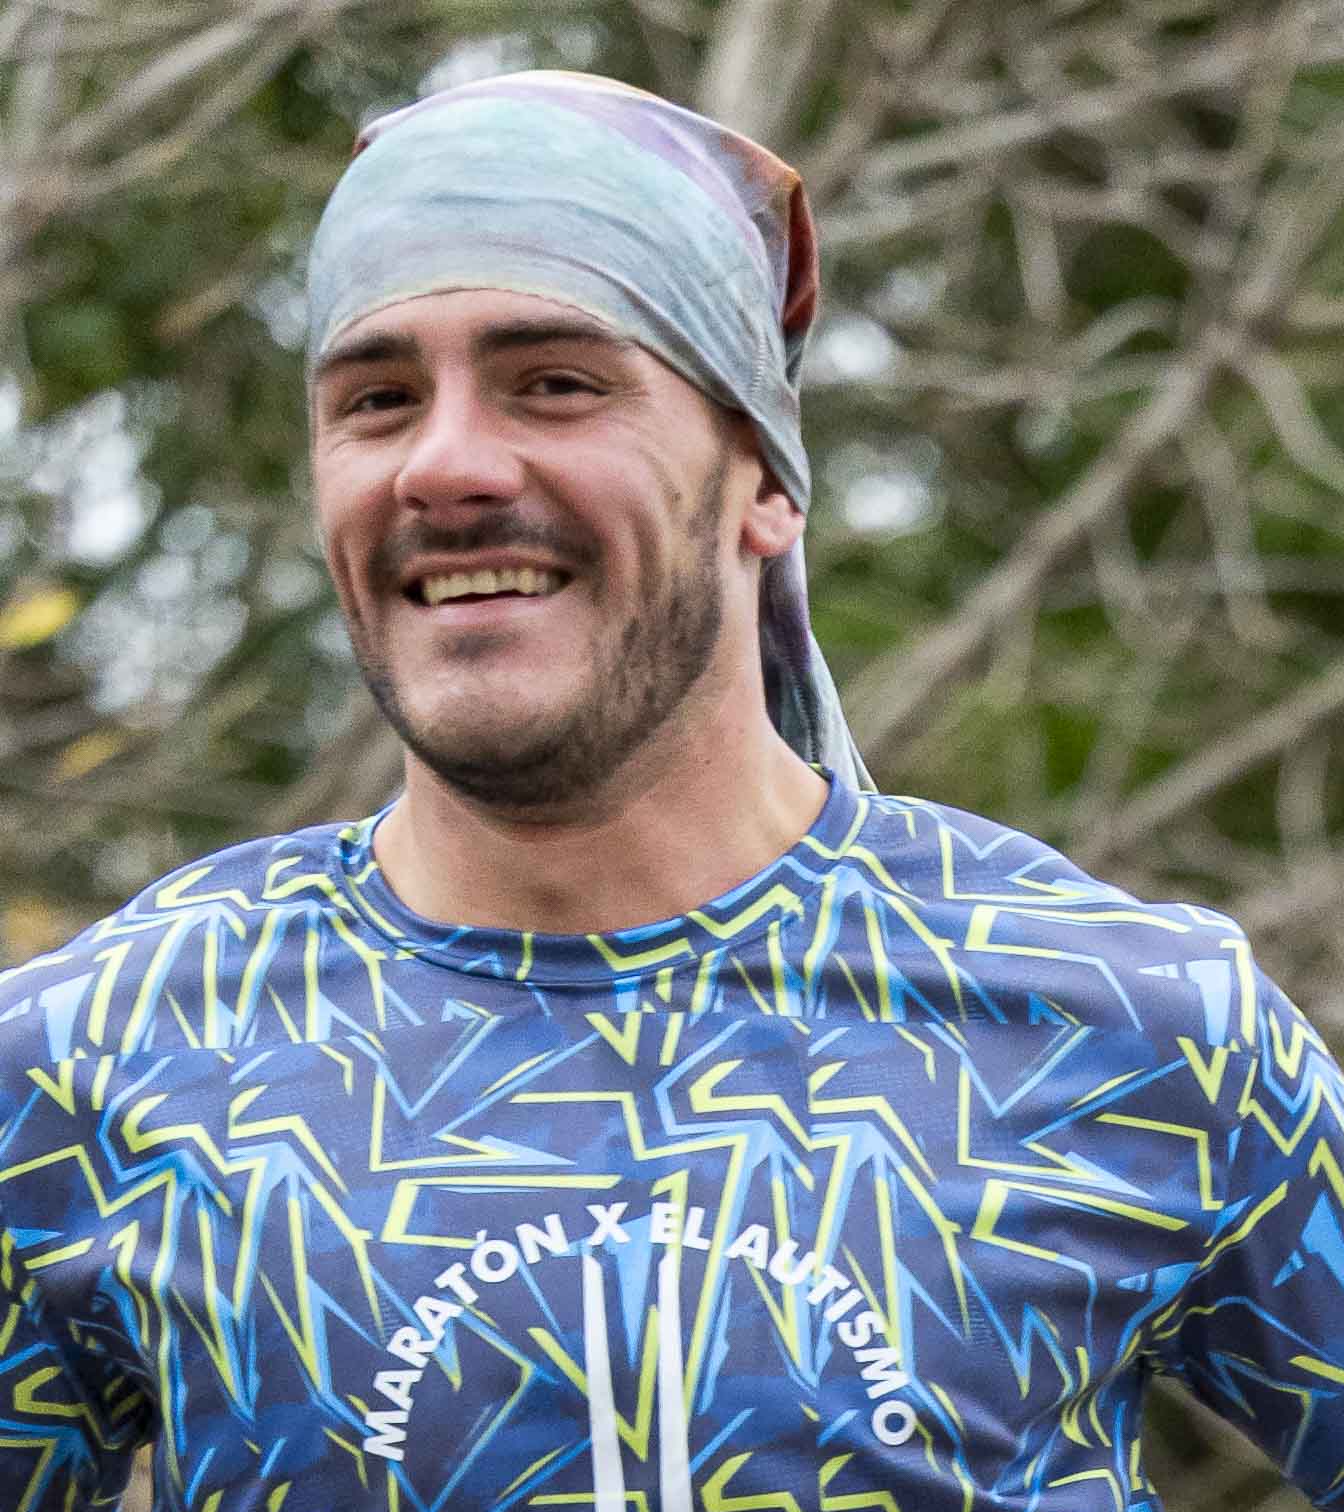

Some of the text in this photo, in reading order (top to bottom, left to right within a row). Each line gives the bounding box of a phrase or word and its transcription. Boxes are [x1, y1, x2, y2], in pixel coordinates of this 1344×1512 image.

[363, 1201, 917, 1462] MARATÓN X EL AUTISMO
